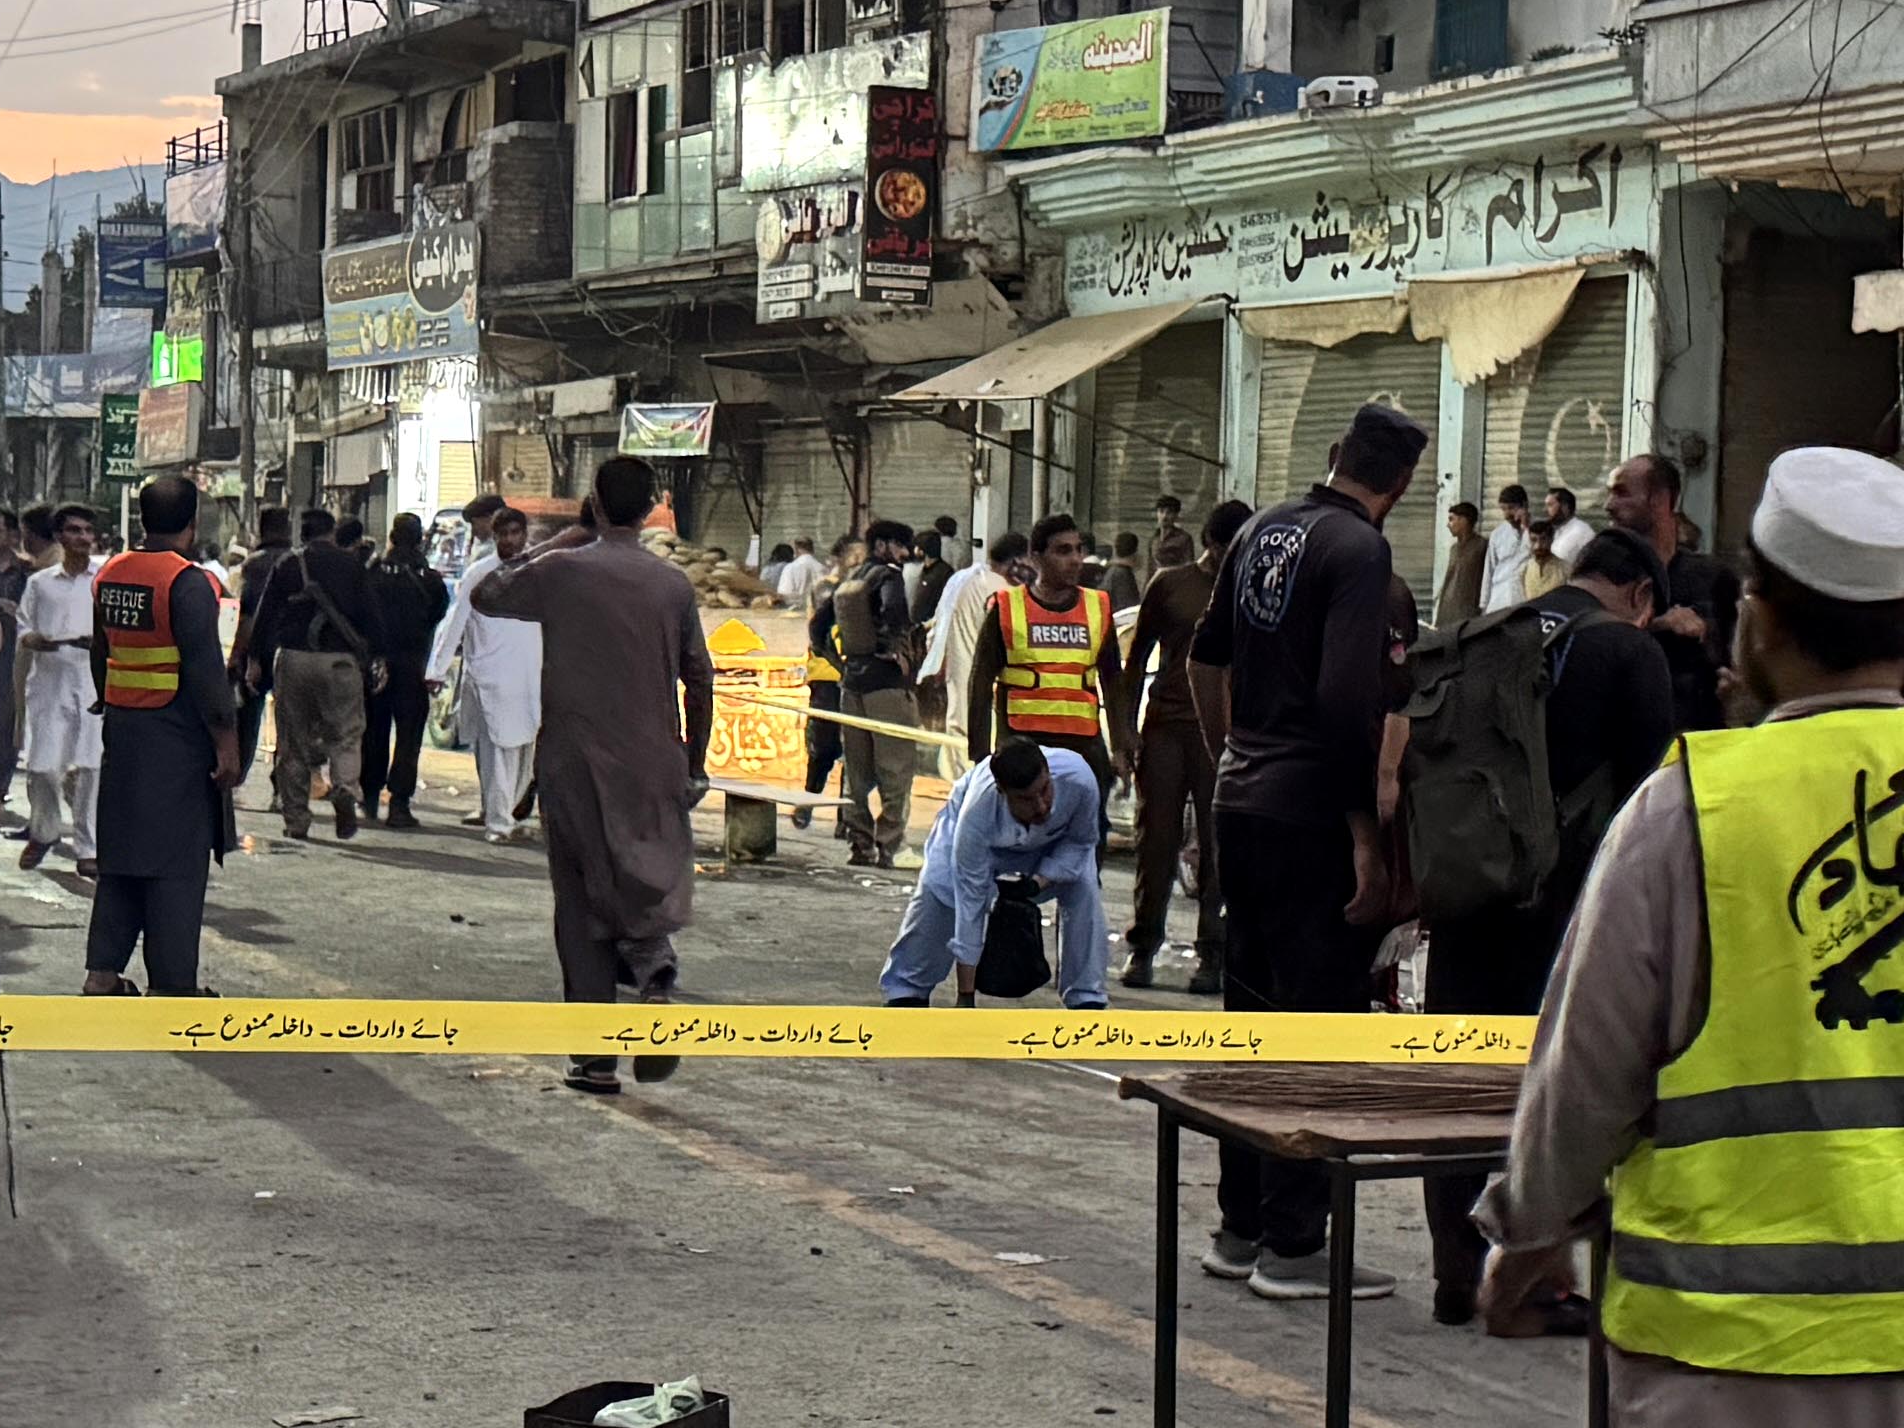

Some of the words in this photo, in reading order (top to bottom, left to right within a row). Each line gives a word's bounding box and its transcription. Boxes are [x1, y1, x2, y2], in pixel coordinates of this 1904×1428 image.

[101, 588, 147, 610] RESCUE
[106, 607, 139, 627] 1122
[1032, 624, 1088, 645] RESCUE
